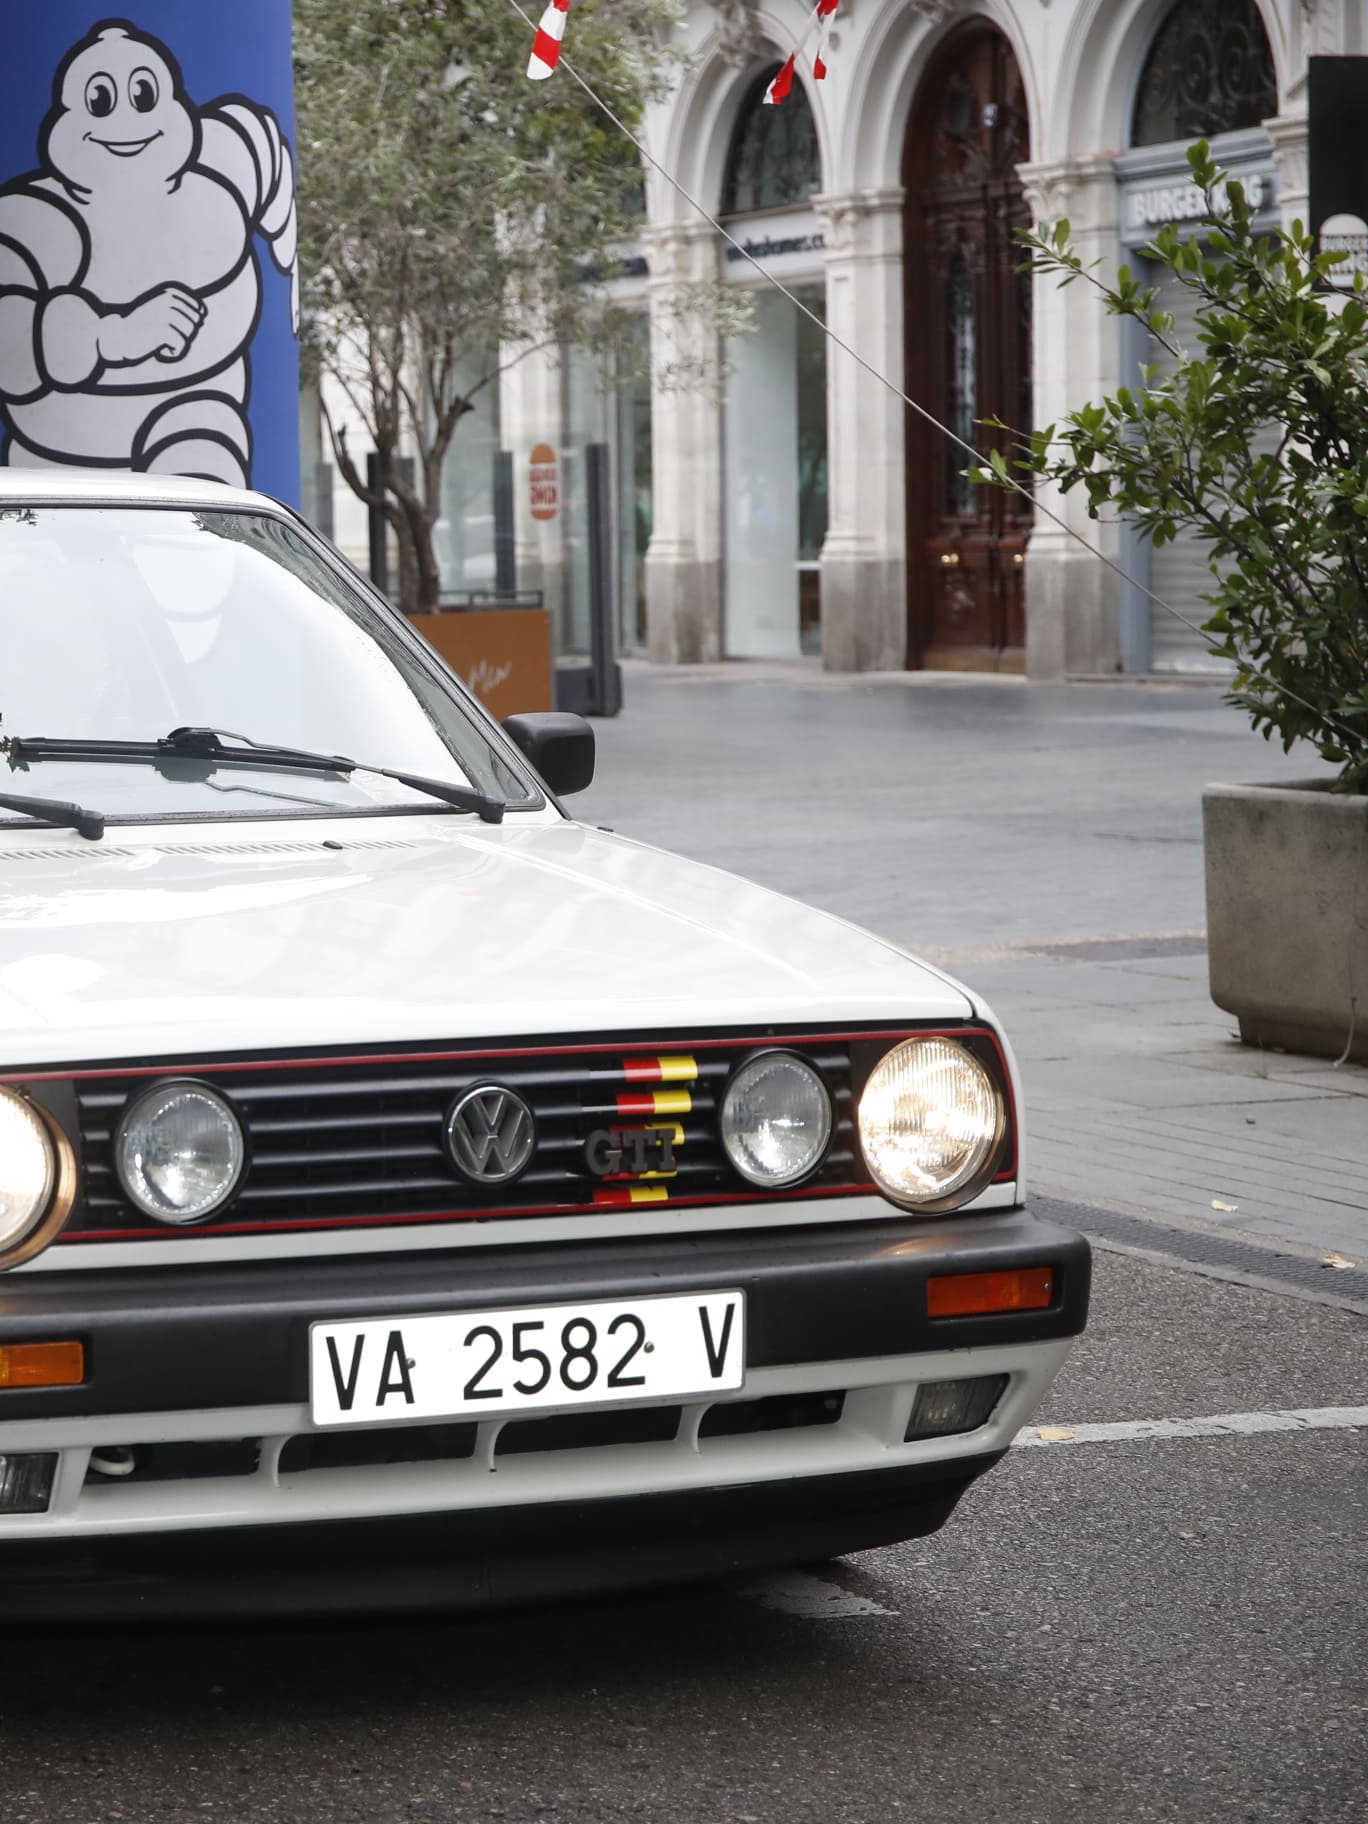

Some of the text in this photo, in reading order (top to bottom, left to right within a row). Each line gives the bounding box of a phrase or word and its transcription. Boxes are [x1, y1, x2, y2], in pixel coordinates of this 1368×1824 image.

[585, 1126, 678, 1176] GTI
[325, 1302, 736, 1411] VA 2582 V
